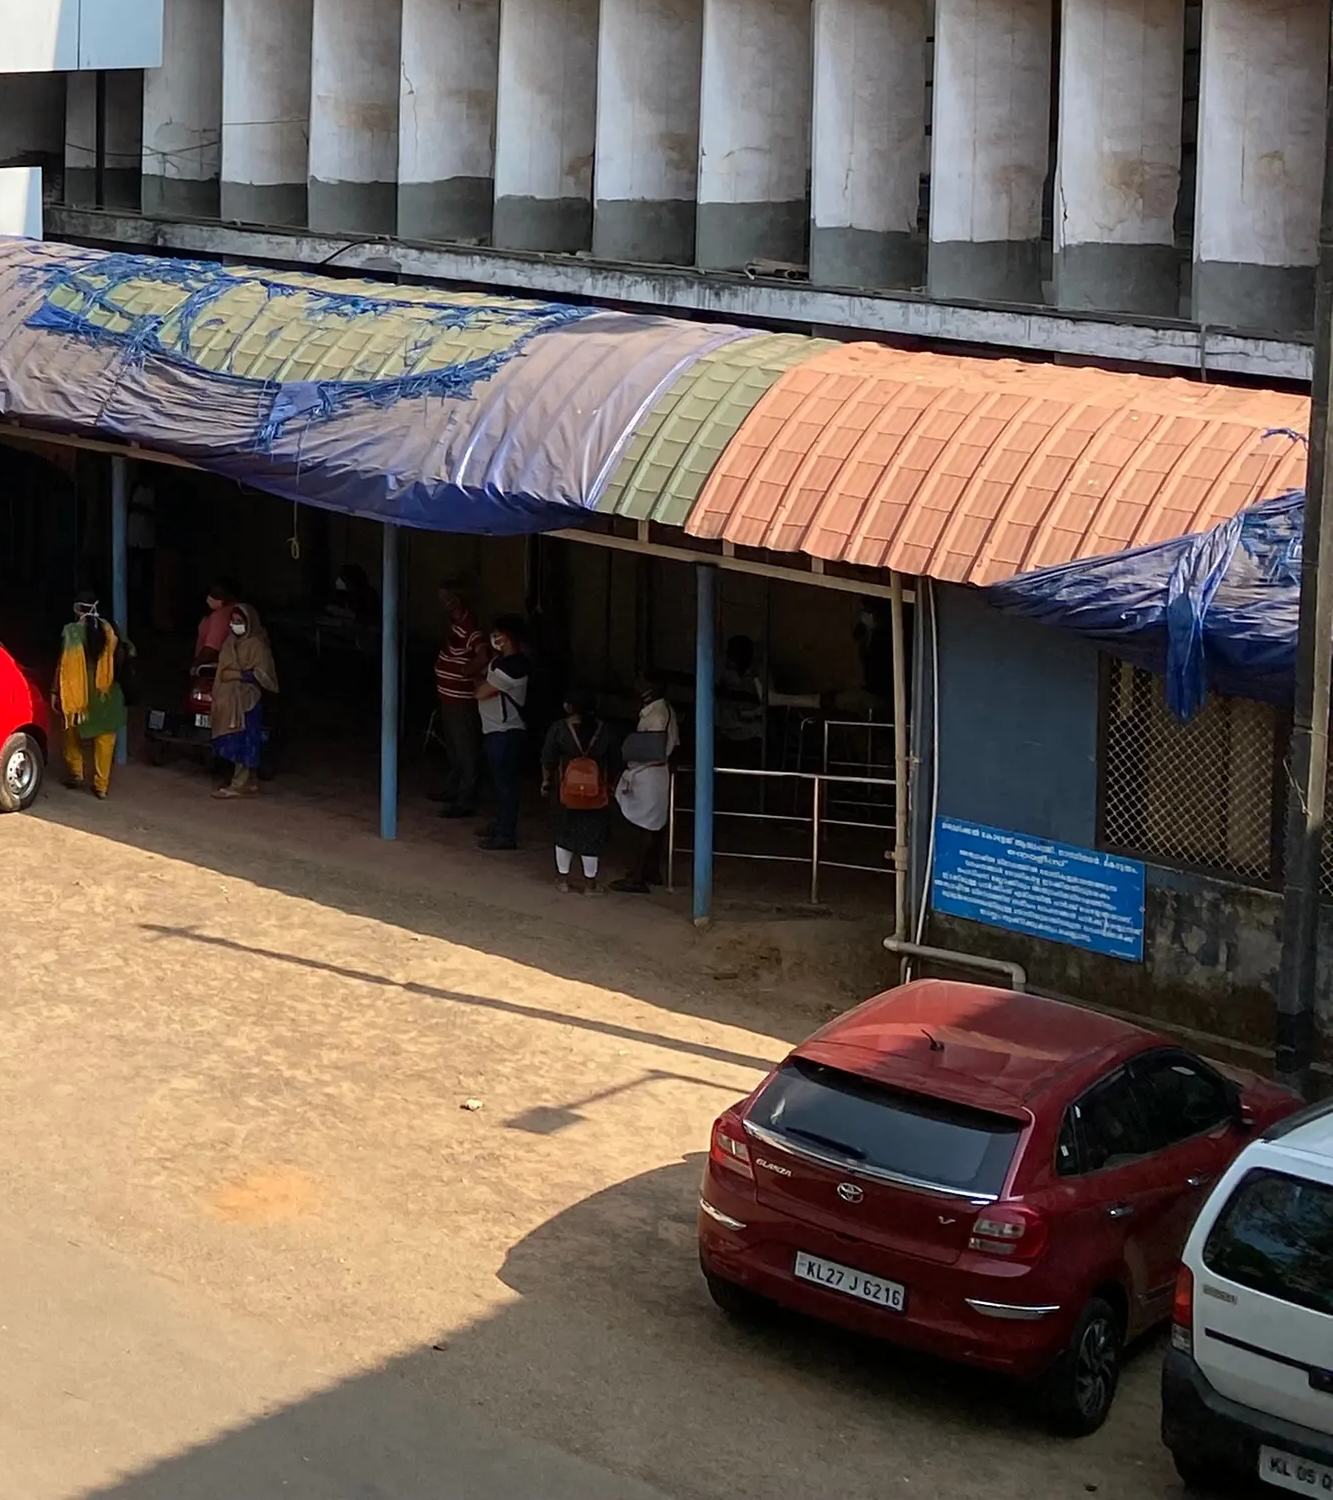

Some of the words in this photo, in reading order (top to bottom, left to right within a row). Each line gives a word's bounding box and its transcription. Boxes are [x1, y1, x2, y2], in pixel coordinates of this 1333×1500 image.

[756, 1158, 792, 1177] GLANZA
[805, 1260, 845, 1286] KL27
[849, 1276, 858, 1291] J
[863, 1280, 901, 1306] 6216
[1269, 1456, 1292, 1477] KL
